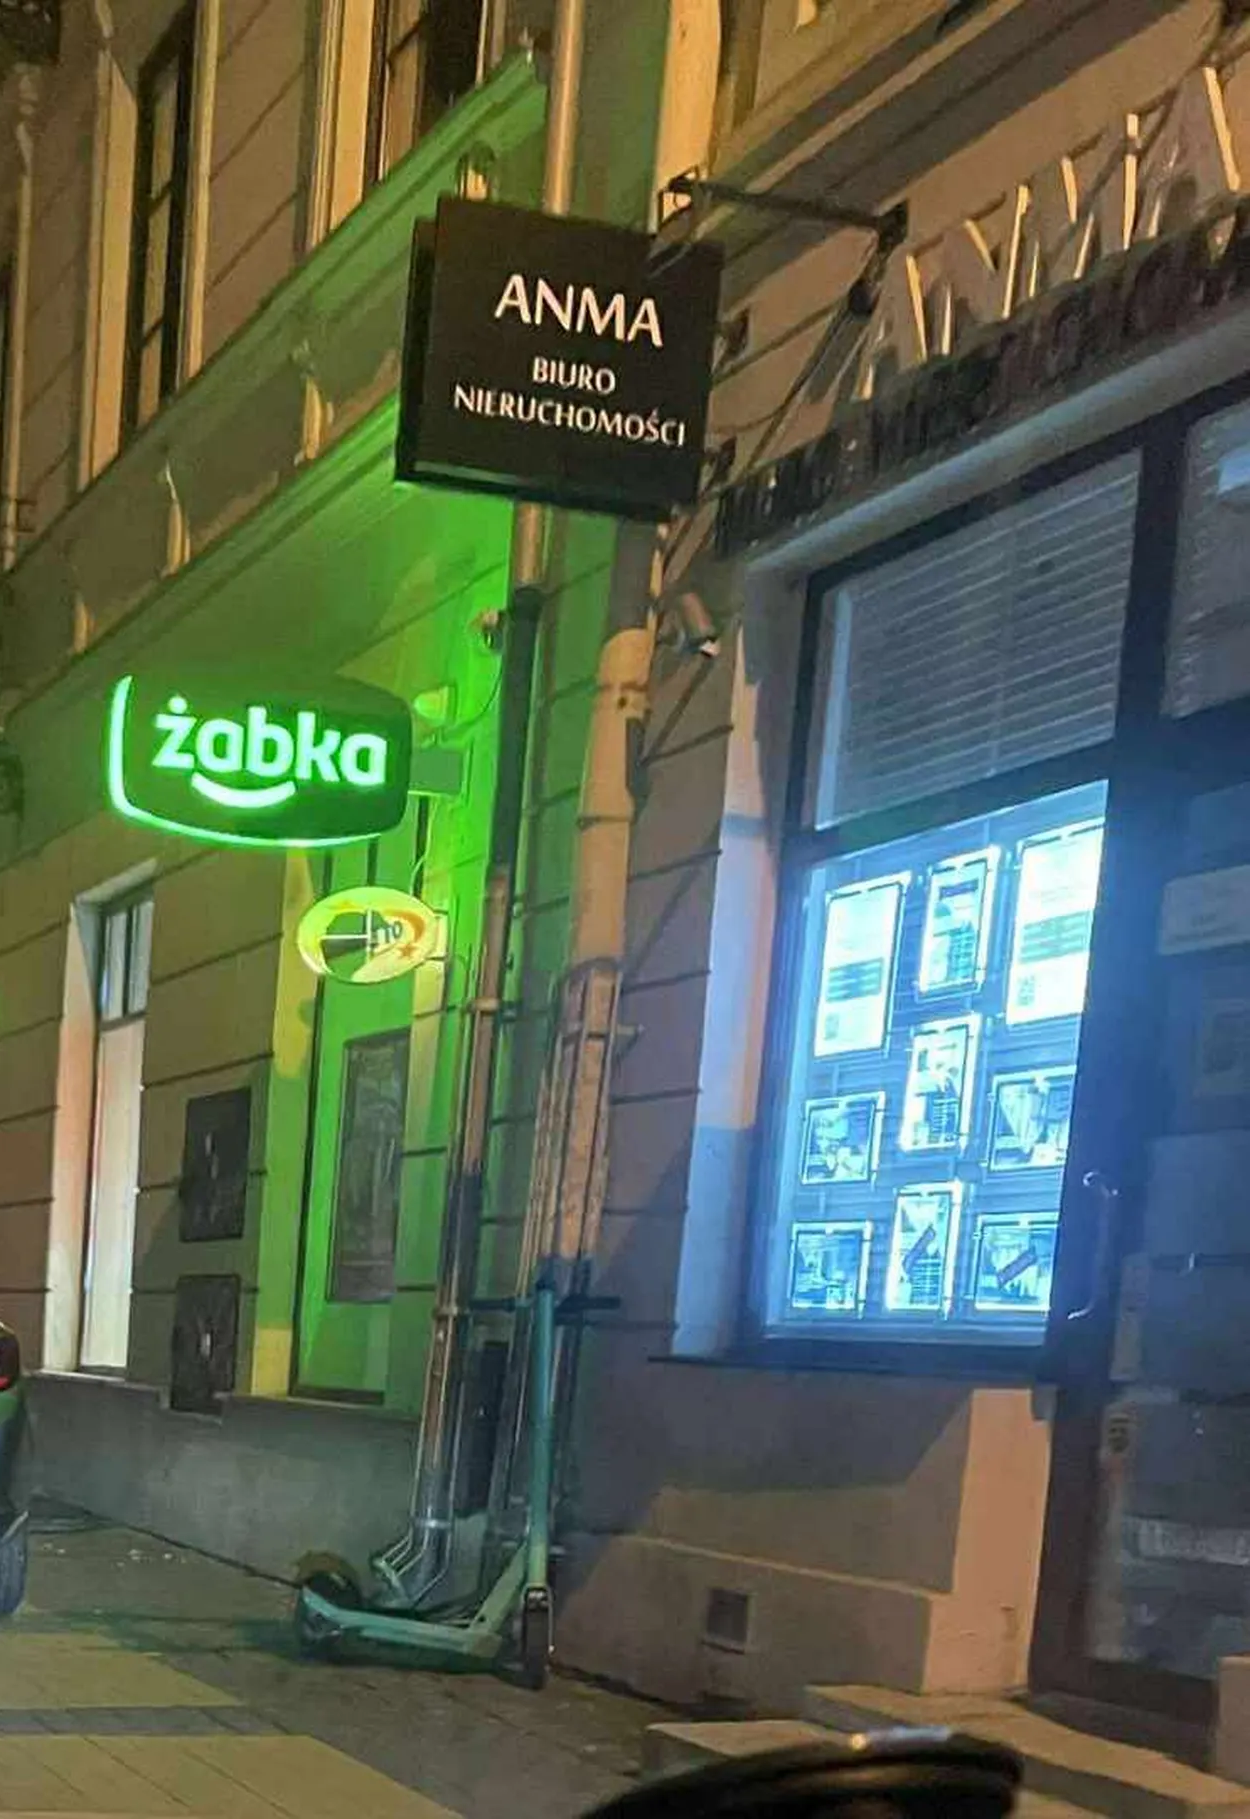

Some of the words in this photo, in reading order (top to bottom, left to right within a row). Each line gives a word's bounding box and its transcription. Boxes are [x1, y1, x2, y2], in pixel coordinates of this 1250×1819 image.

[494, 273, 663, 347] ANMA
[532, 356, 616, 395] BIURO
[453, 384, 686, 447] NIERUCHOMOŚCI
[152, 696, 387, 785] żabka
